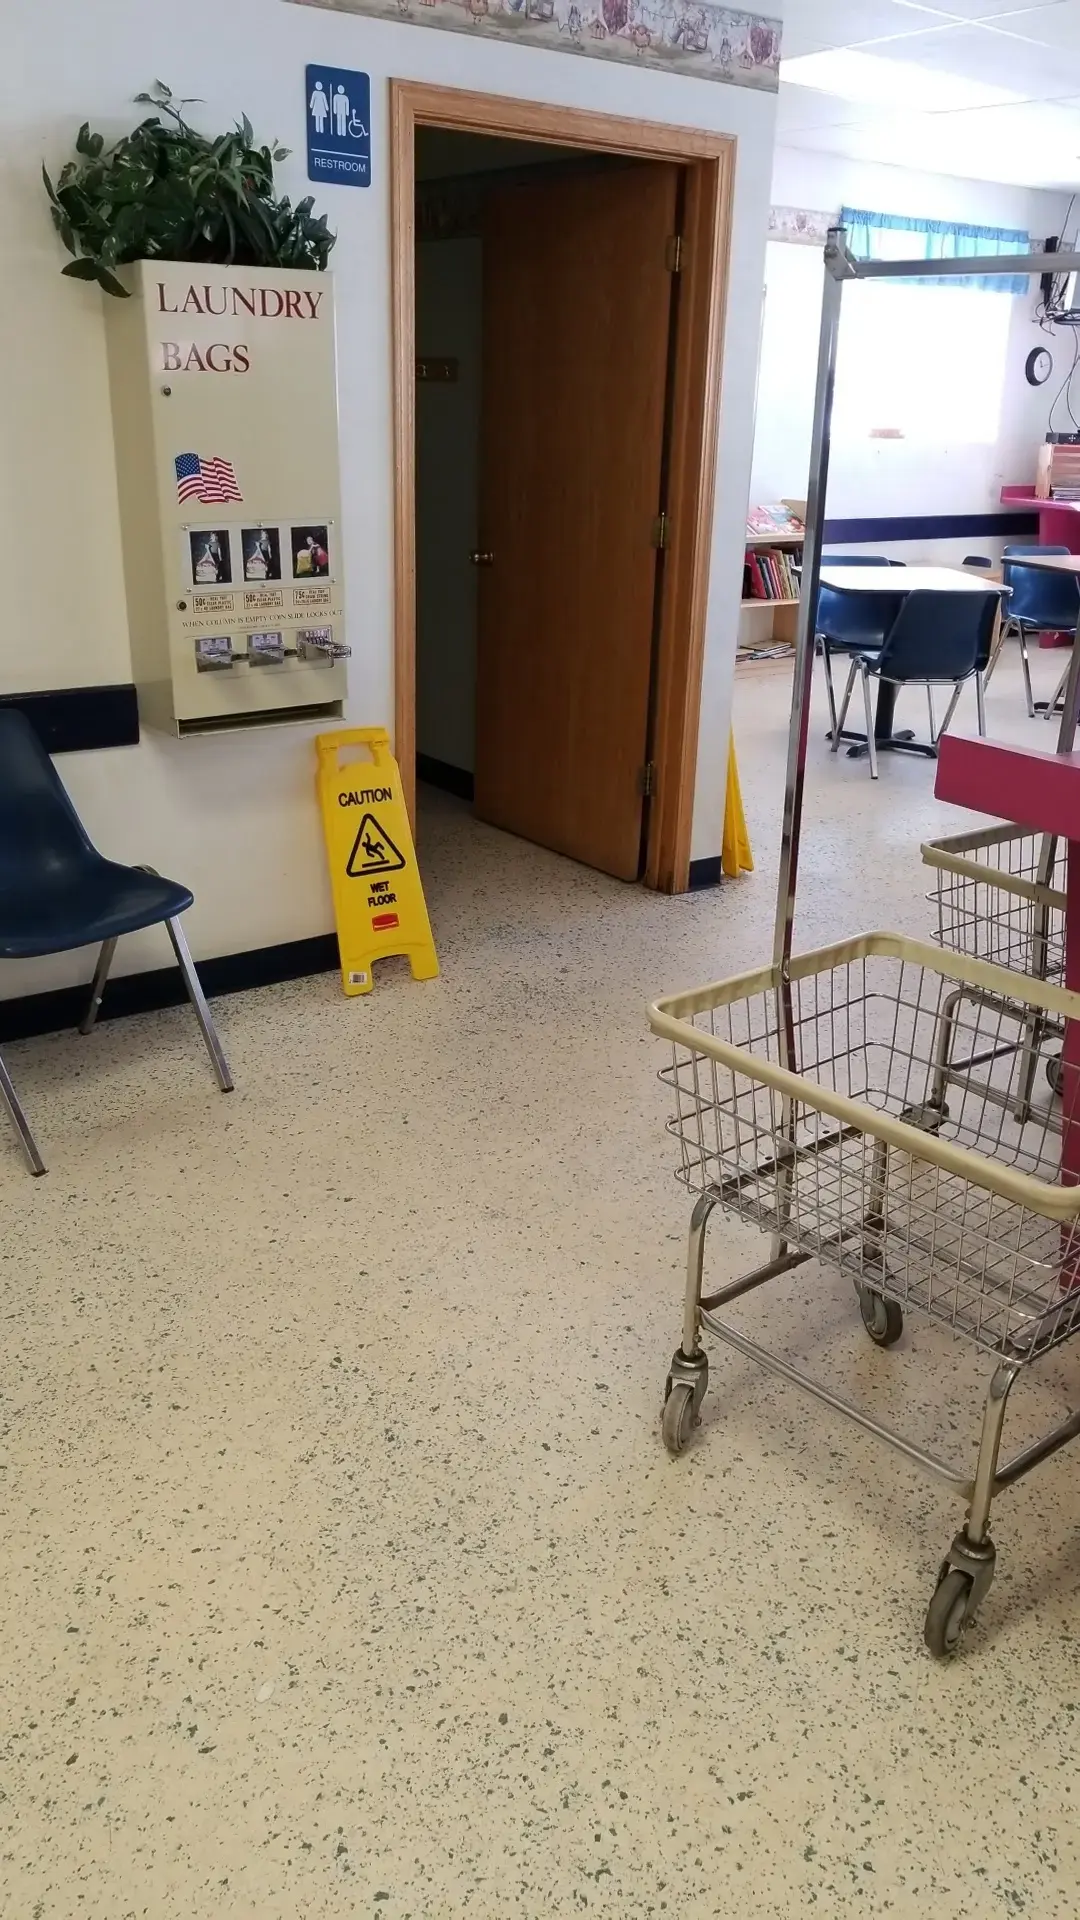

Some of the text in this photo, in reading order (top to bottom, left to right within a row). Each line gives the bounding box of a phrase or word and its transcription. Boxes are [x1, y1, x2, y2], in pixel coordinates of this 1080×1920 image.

[314, 157, 366, 173] RESTROOM
[156, 283, 324, 319] LAUNDRY
[160, 342, 250, 373] BAGS
[194, 597, 206, 606] 50¢
[246, 594, 256, 602] 50¢
[206, 617, 236, 626] COLUMN
[245, 615, 268, 623] EMPTY
[338, 787, 393, 807] CAUTION
[370, 881, 390, 894] WET
[367, 893, 397, 908] FLOOR
